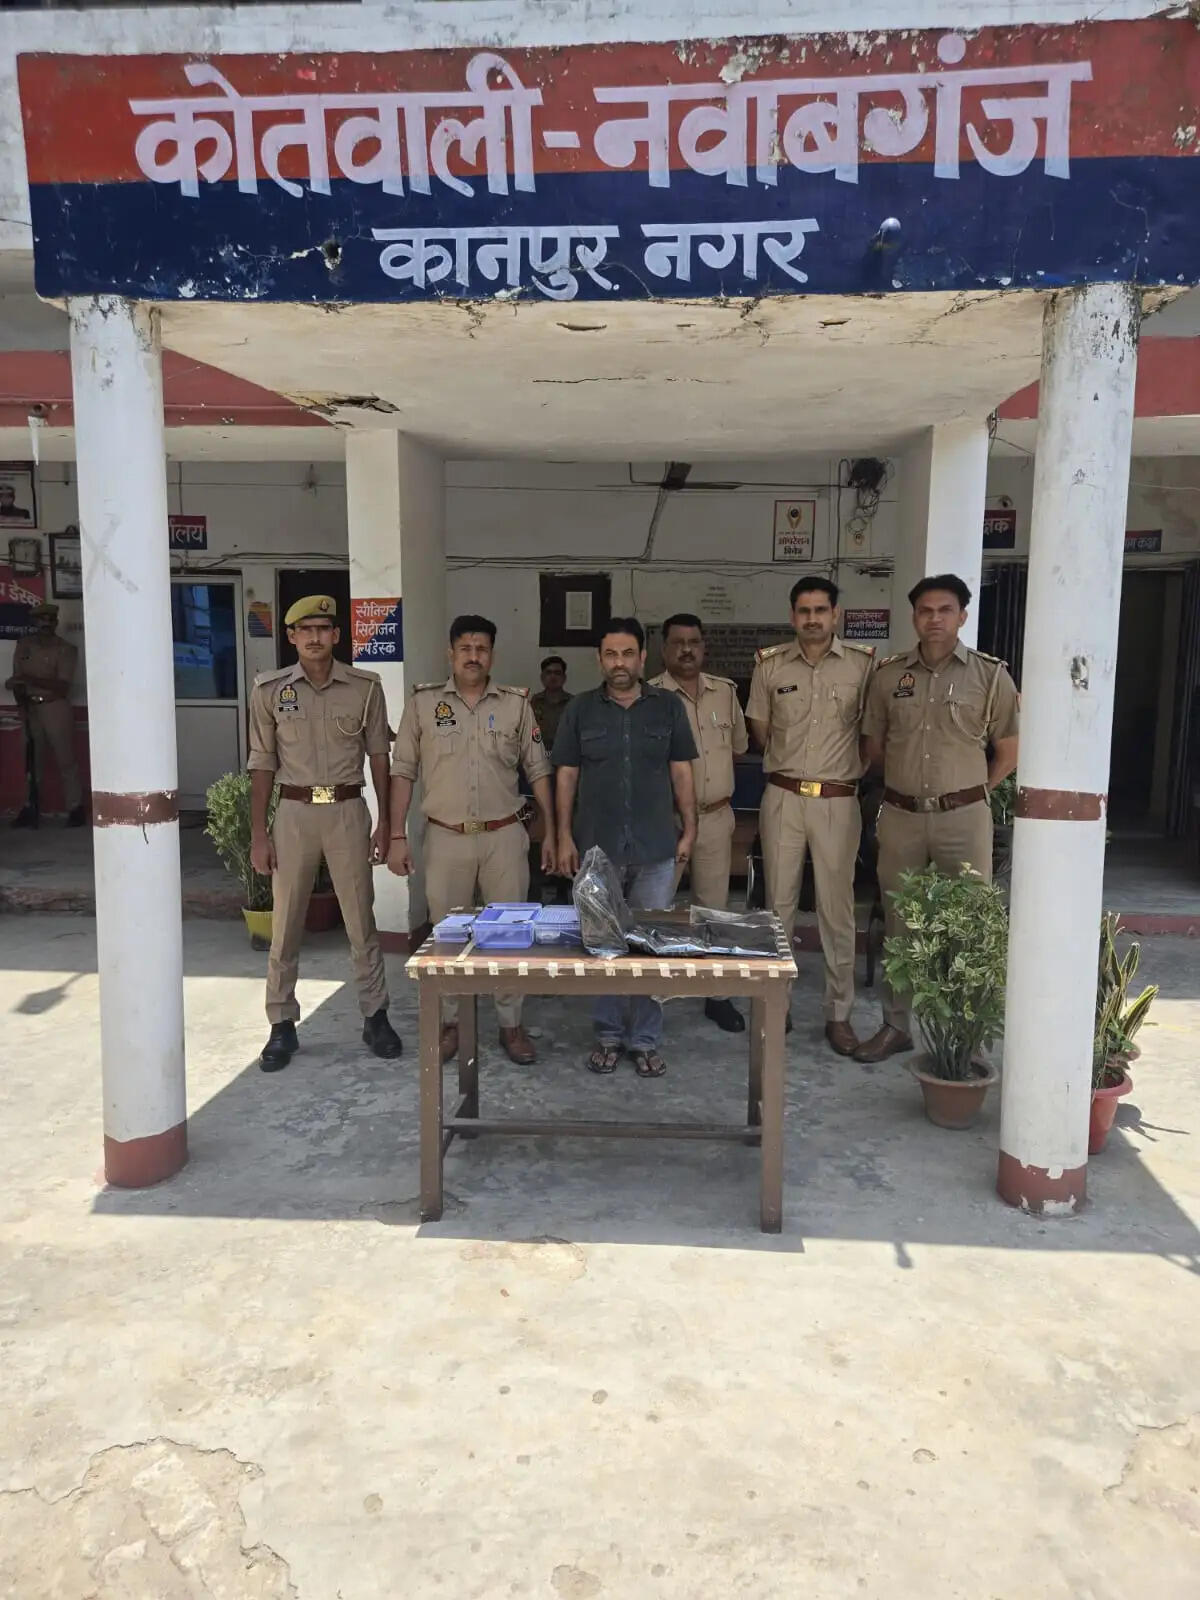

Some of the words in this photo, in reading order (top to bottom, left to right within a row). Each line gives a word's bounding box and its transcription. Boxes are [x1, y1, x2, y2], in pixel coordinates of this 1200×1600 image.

[371, 226, 620, 300] कानपुर
[641, 218, 820, 283] नगर
[355, 601, 398, 617] सीनियर
[354, 620, 398, 637] सिटीजन
